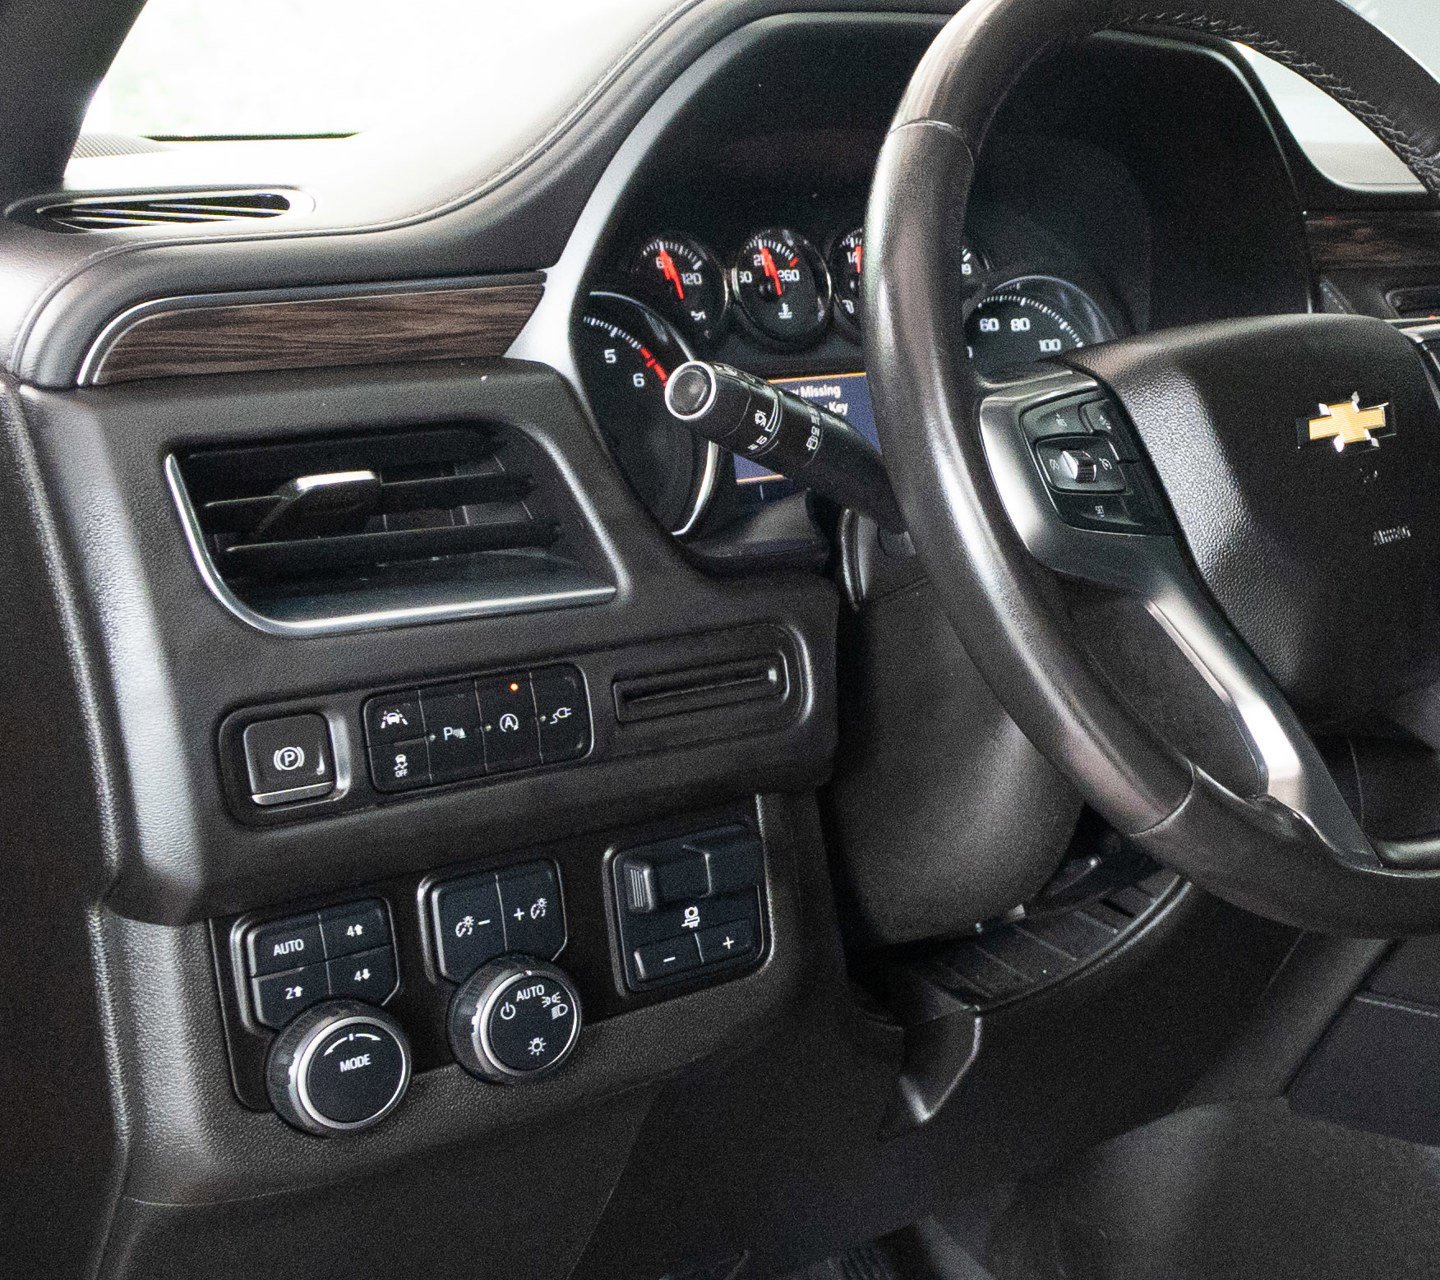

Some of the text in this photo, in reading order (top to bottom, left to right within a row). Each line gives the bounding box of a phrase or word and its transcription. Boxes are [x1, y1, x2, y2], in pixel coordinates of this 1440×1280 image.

[680, 271, 702, 286] 120
[979, 318, 1000, 332] 60
[1010, 317, 1031, 332] 80
[1038, 338, 1061, 353] 100
[604, 348, 617, 365] 5
[633, 372, 645, 388] 6
[800, 384, 841, 400] Missing
[395, 770, 407, 778] OFF
[273, 938, 304, 957] AUTO
[516, 983, 545, 1002] AUTO
[339, 1053, 371, 1072] MODE
